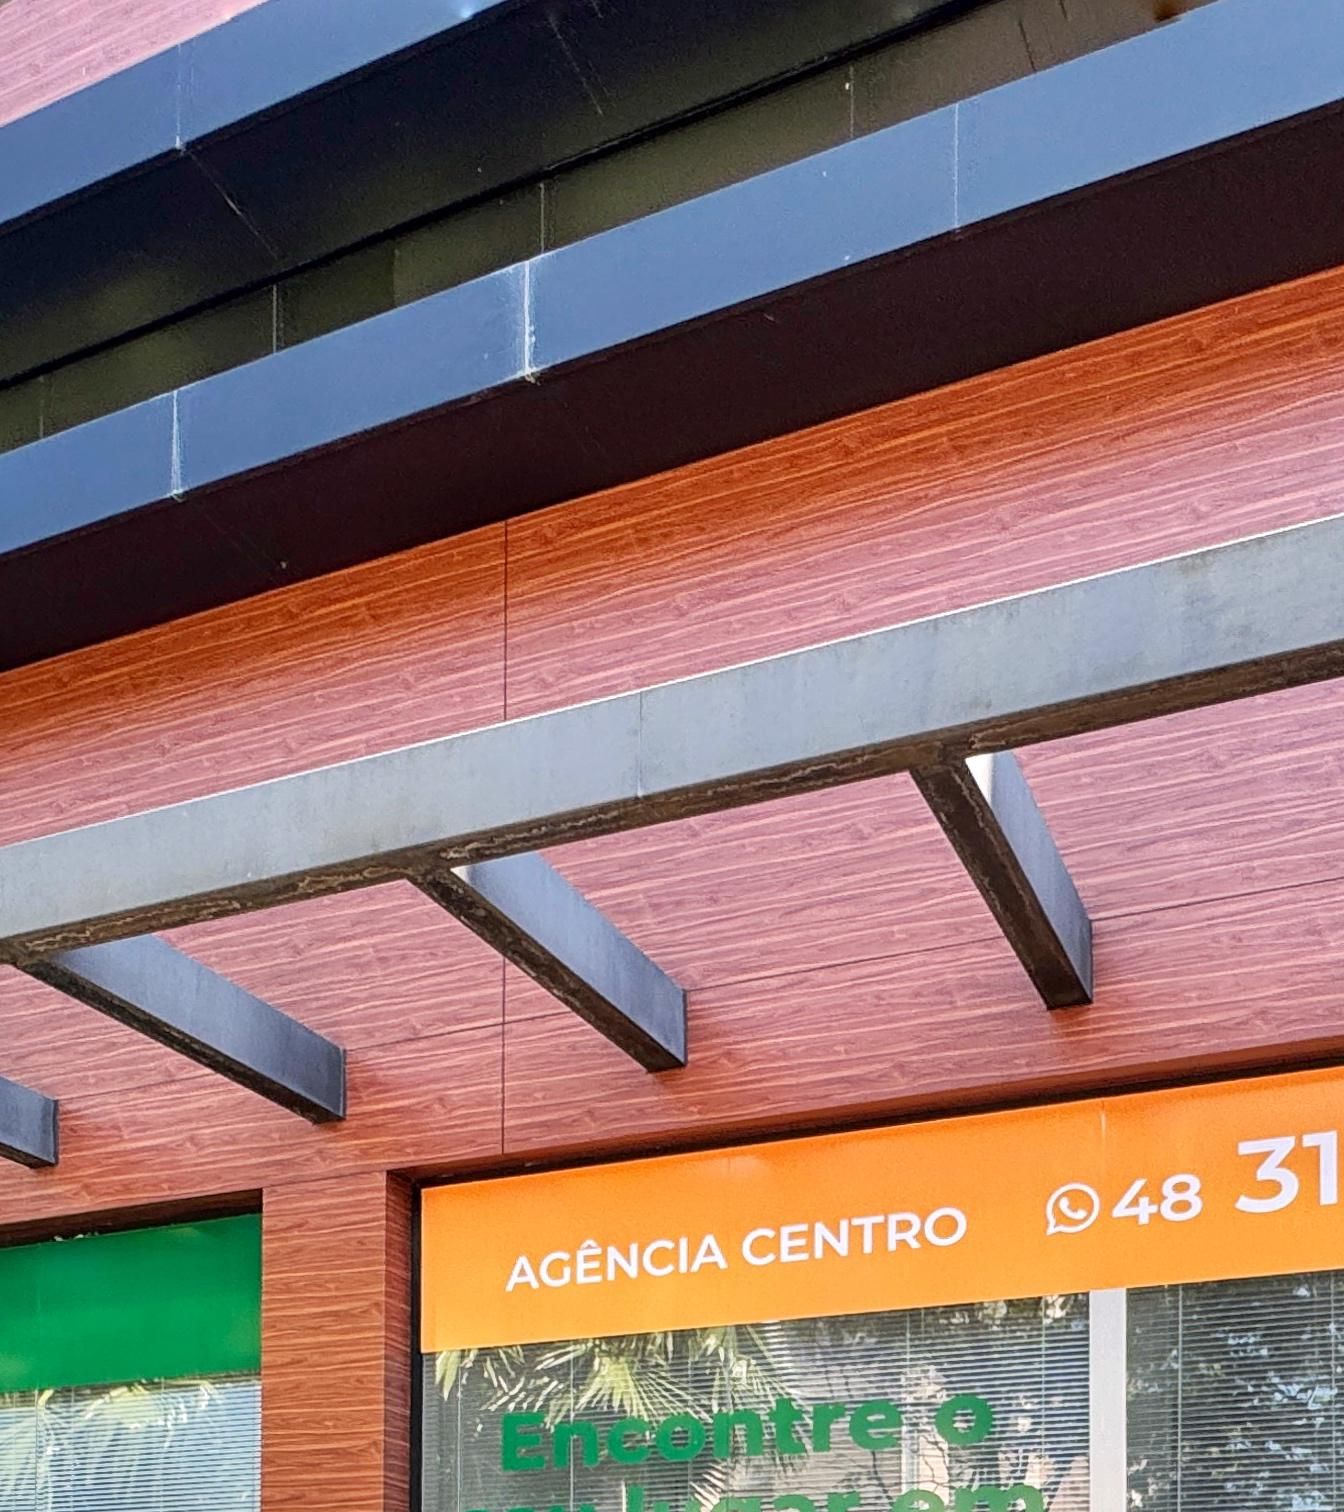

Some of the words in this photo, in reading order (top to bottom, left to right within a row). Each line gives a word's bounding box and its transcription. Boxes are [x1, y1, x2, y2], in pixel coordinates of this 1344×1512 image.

[505, 1233, 728, 1293] AGÊNCIA
[741, 1205, 968, 1266] CENTRO
[1112, 1173, 1204, 1226] 48
[500, 1396, 902, 1472] Encontre
[935, 1393, 993, 1447] o
